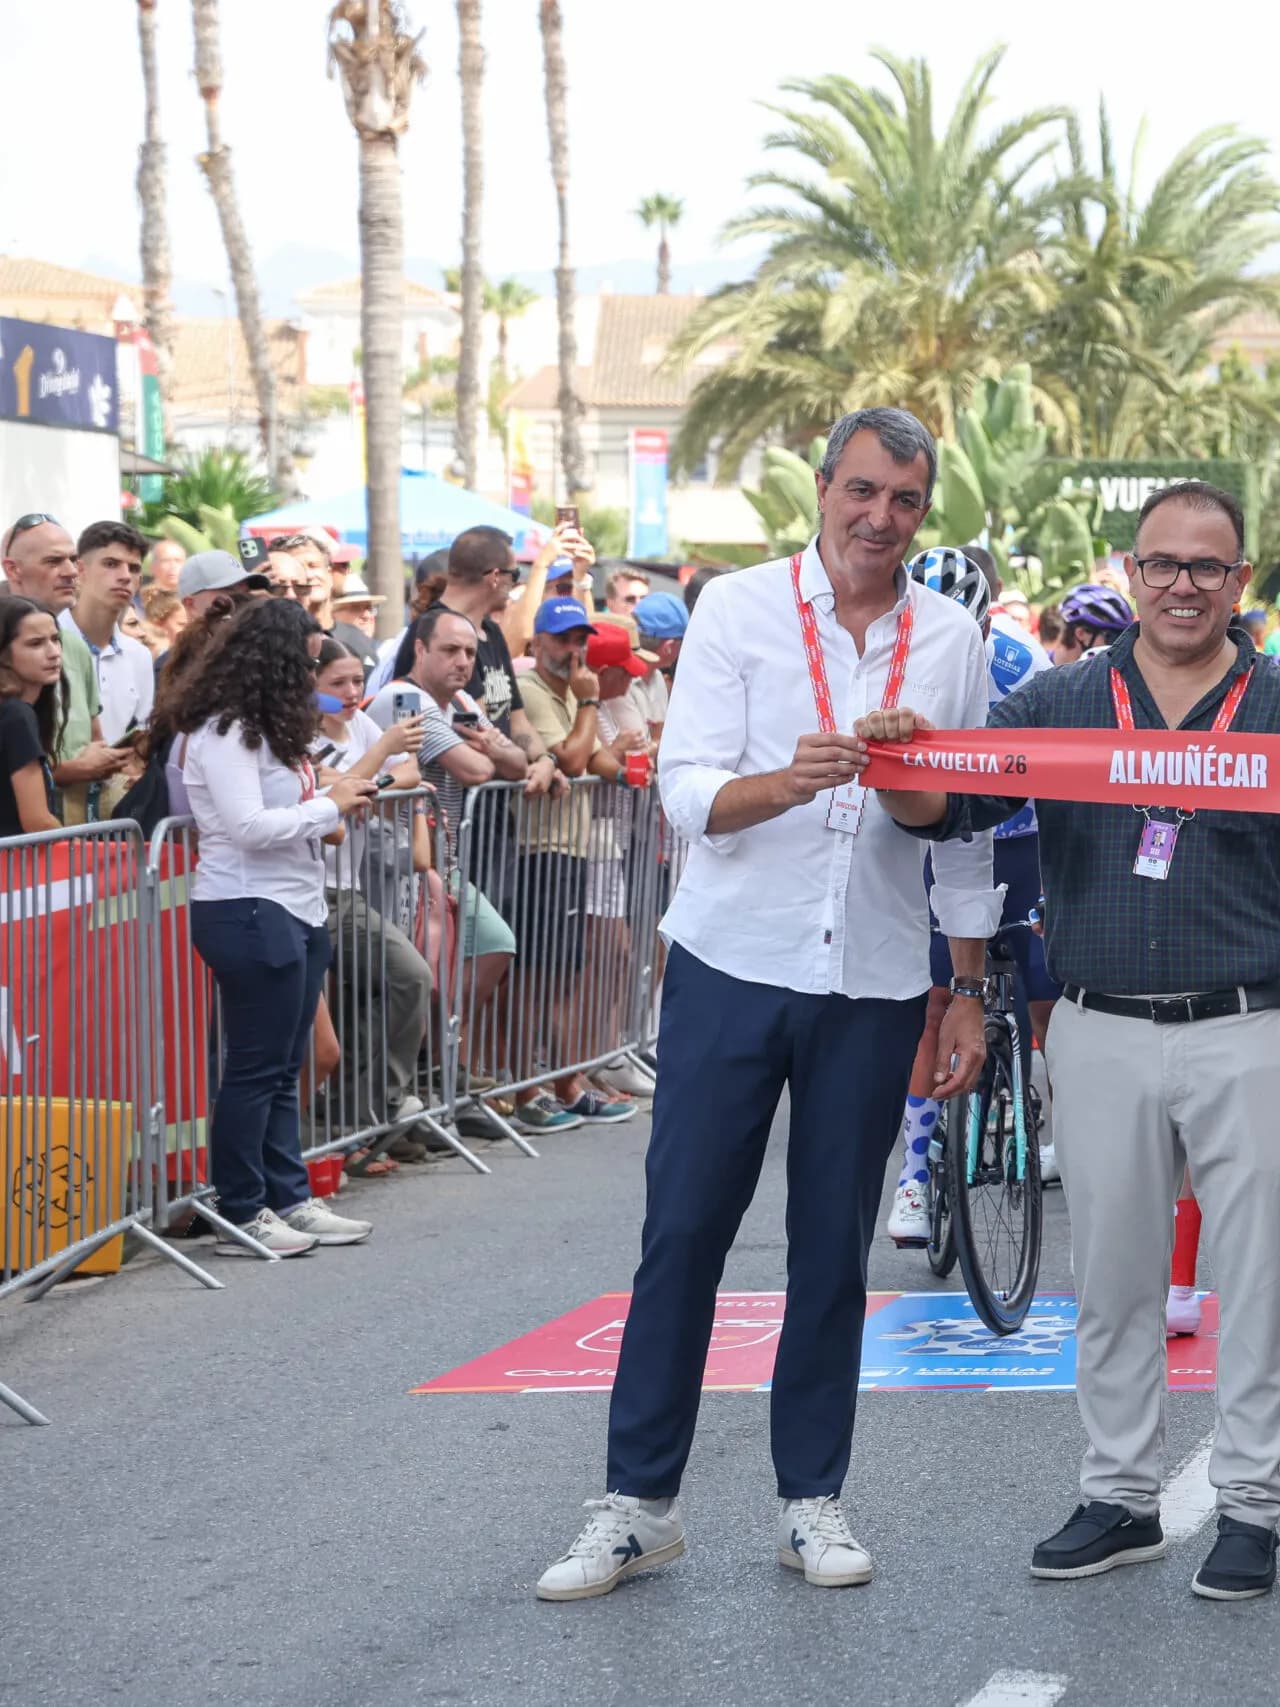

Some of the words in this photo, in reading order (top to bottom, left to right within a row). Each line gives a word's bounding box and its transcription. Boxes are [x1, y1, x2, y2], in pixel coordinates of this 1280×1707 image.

[903, 752, 925, 767] LA
[928, 751, 1000, 774] VUELTA
[1004, 754, 1027, 775] 26
[1109, 744, 1268, 789] ALMUÑÉCAR
